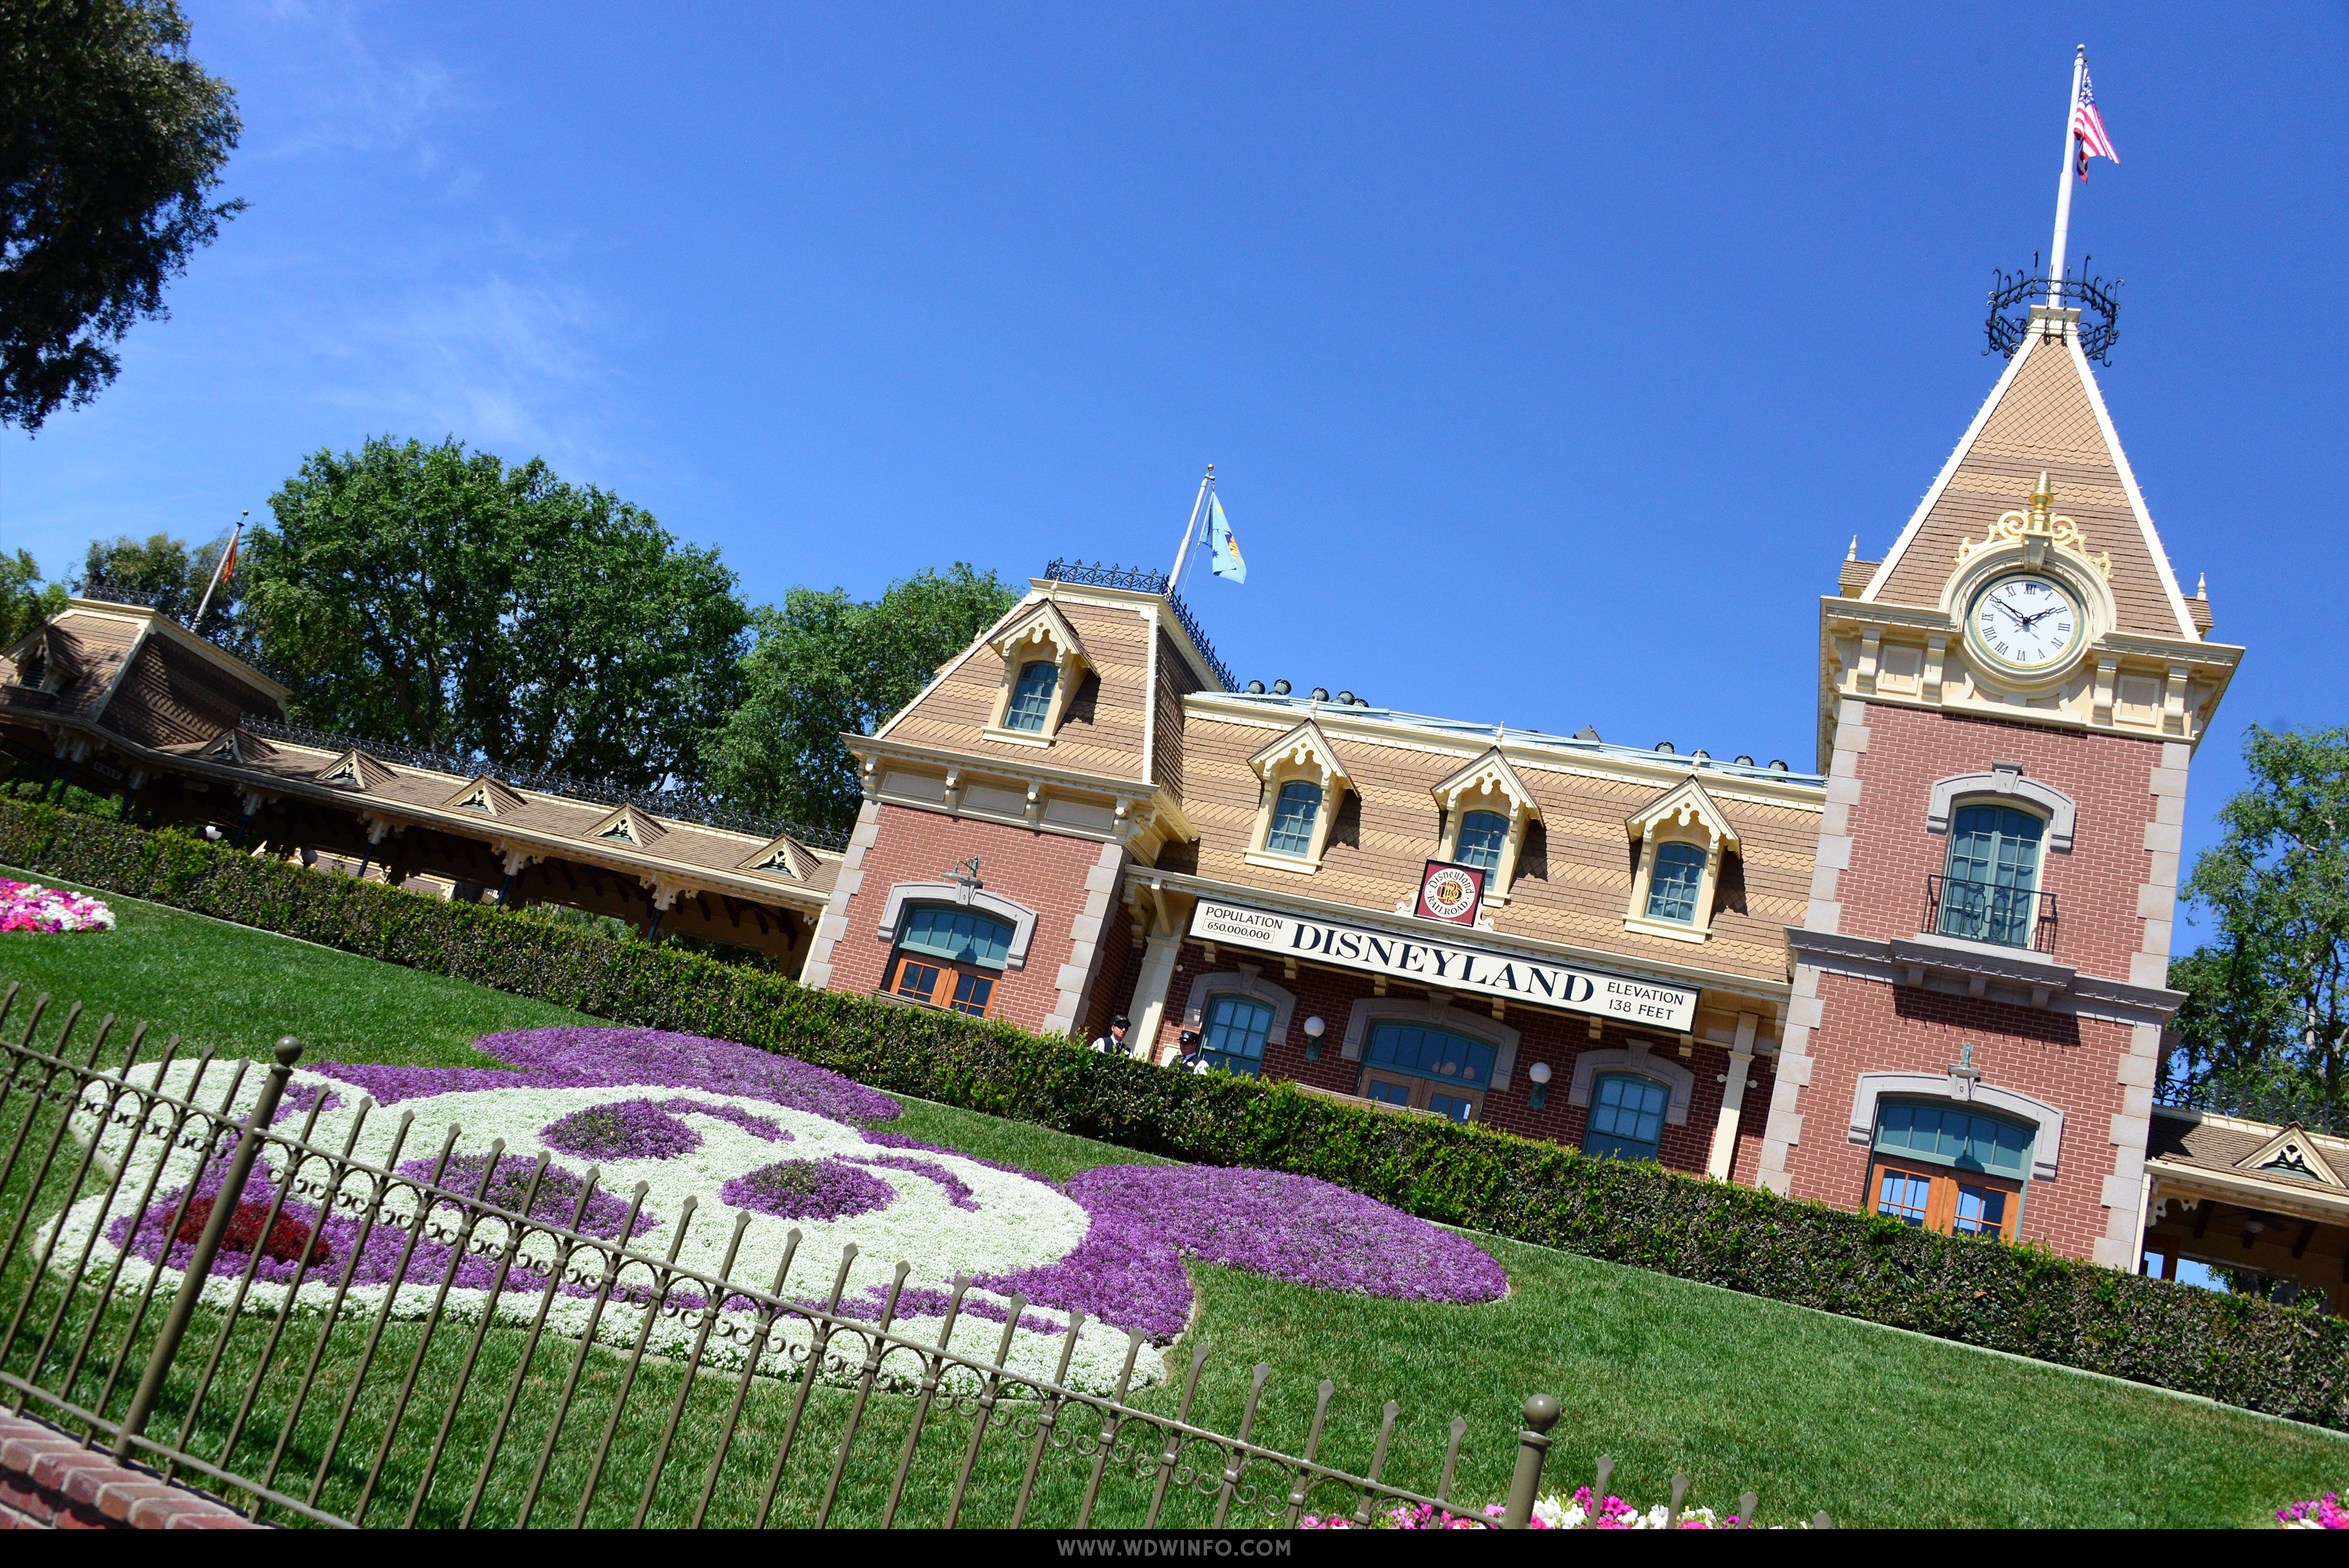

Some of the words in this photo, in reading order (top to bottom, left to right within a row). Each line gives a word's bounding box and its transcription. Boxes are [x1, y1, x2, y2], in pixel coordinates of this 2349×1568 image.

[2004, 586, 2016, 597] XI
[2024, 583, 2037, 595] XII
[2045, 592, 2053, 601] I
[1981, 613, 1994, 621] IX
[1983, 626, 1998, 642] VIII
[2058, 623, 2071, 632] III
[1994, 641, 2009, 655] VII
[2051, 638, 2064, 650] IV
[2016, 650, 2026, 662] VI
[2038, 648, 2046, 660] V
[1427, 870, 1475, 894] Disneyland
[1427, 895, 1468, 916] RAILROAD
[1206, 906, 1283, 930] POPULATION
[1207, 922, 1270, 940] 650,000,000
[1289, 922, 1595, 1004] DISNEYLAND
[1607, 982, 1684, 1005] ELEVATION
[1609, 999, 1632, 1012] 138
[1638, 1004, 1674, 1020] FEET
